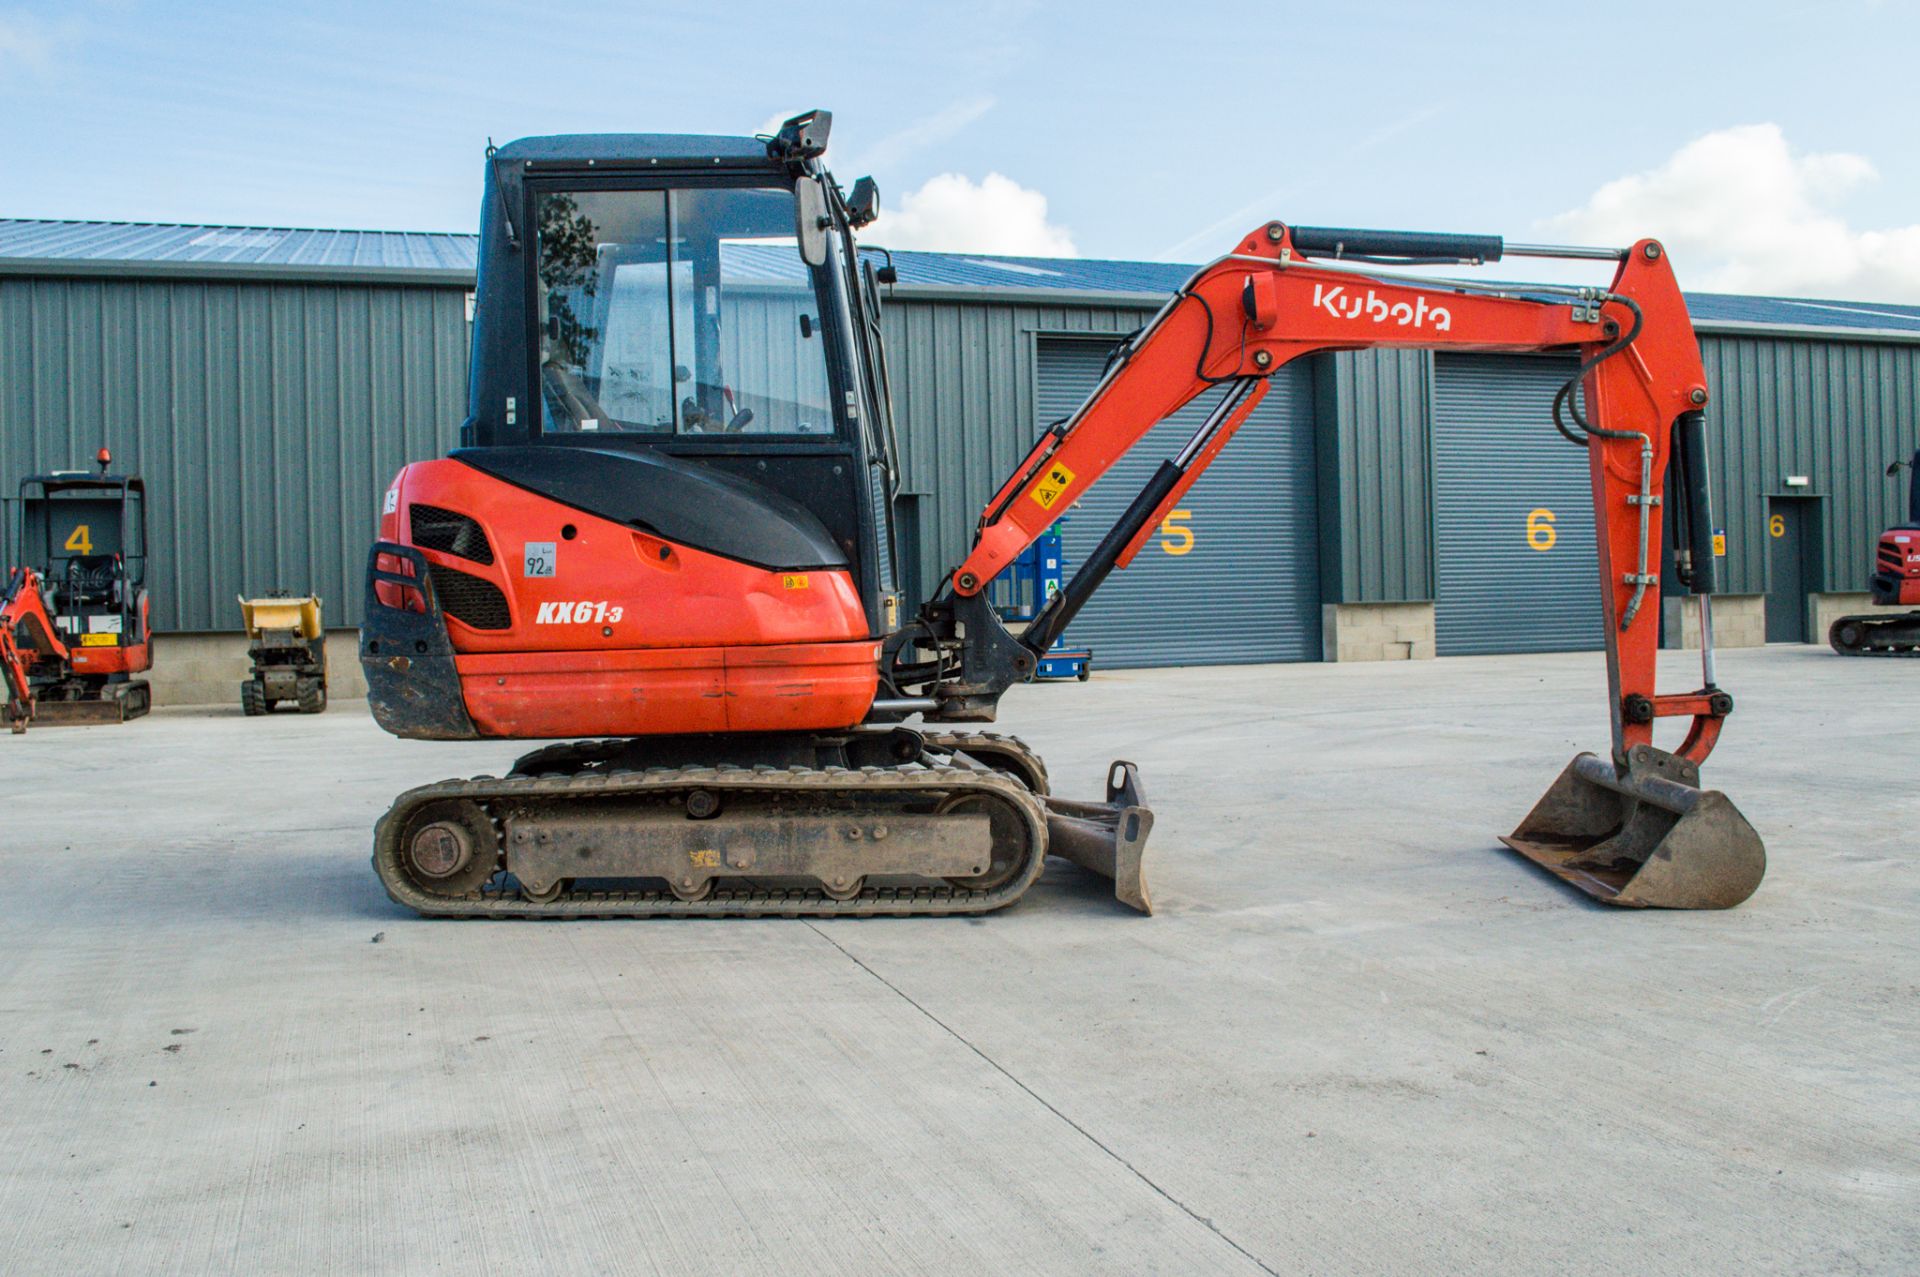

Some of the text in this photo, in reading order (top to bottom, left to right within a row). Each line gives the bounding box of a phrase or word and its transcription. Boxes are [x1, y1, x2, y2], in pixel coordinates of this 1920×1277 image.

[1313, 284, 1451, 331] Kubota
[64, 525, 93, 556] 4
[1161, 509, 1194, 555] 5
[1527, 508, 1557, 551] 6
[1769, 514, 1785, 538] 6
[527, 557, 544, 575] 92
[535, 601, 624, 624] KX61-3
